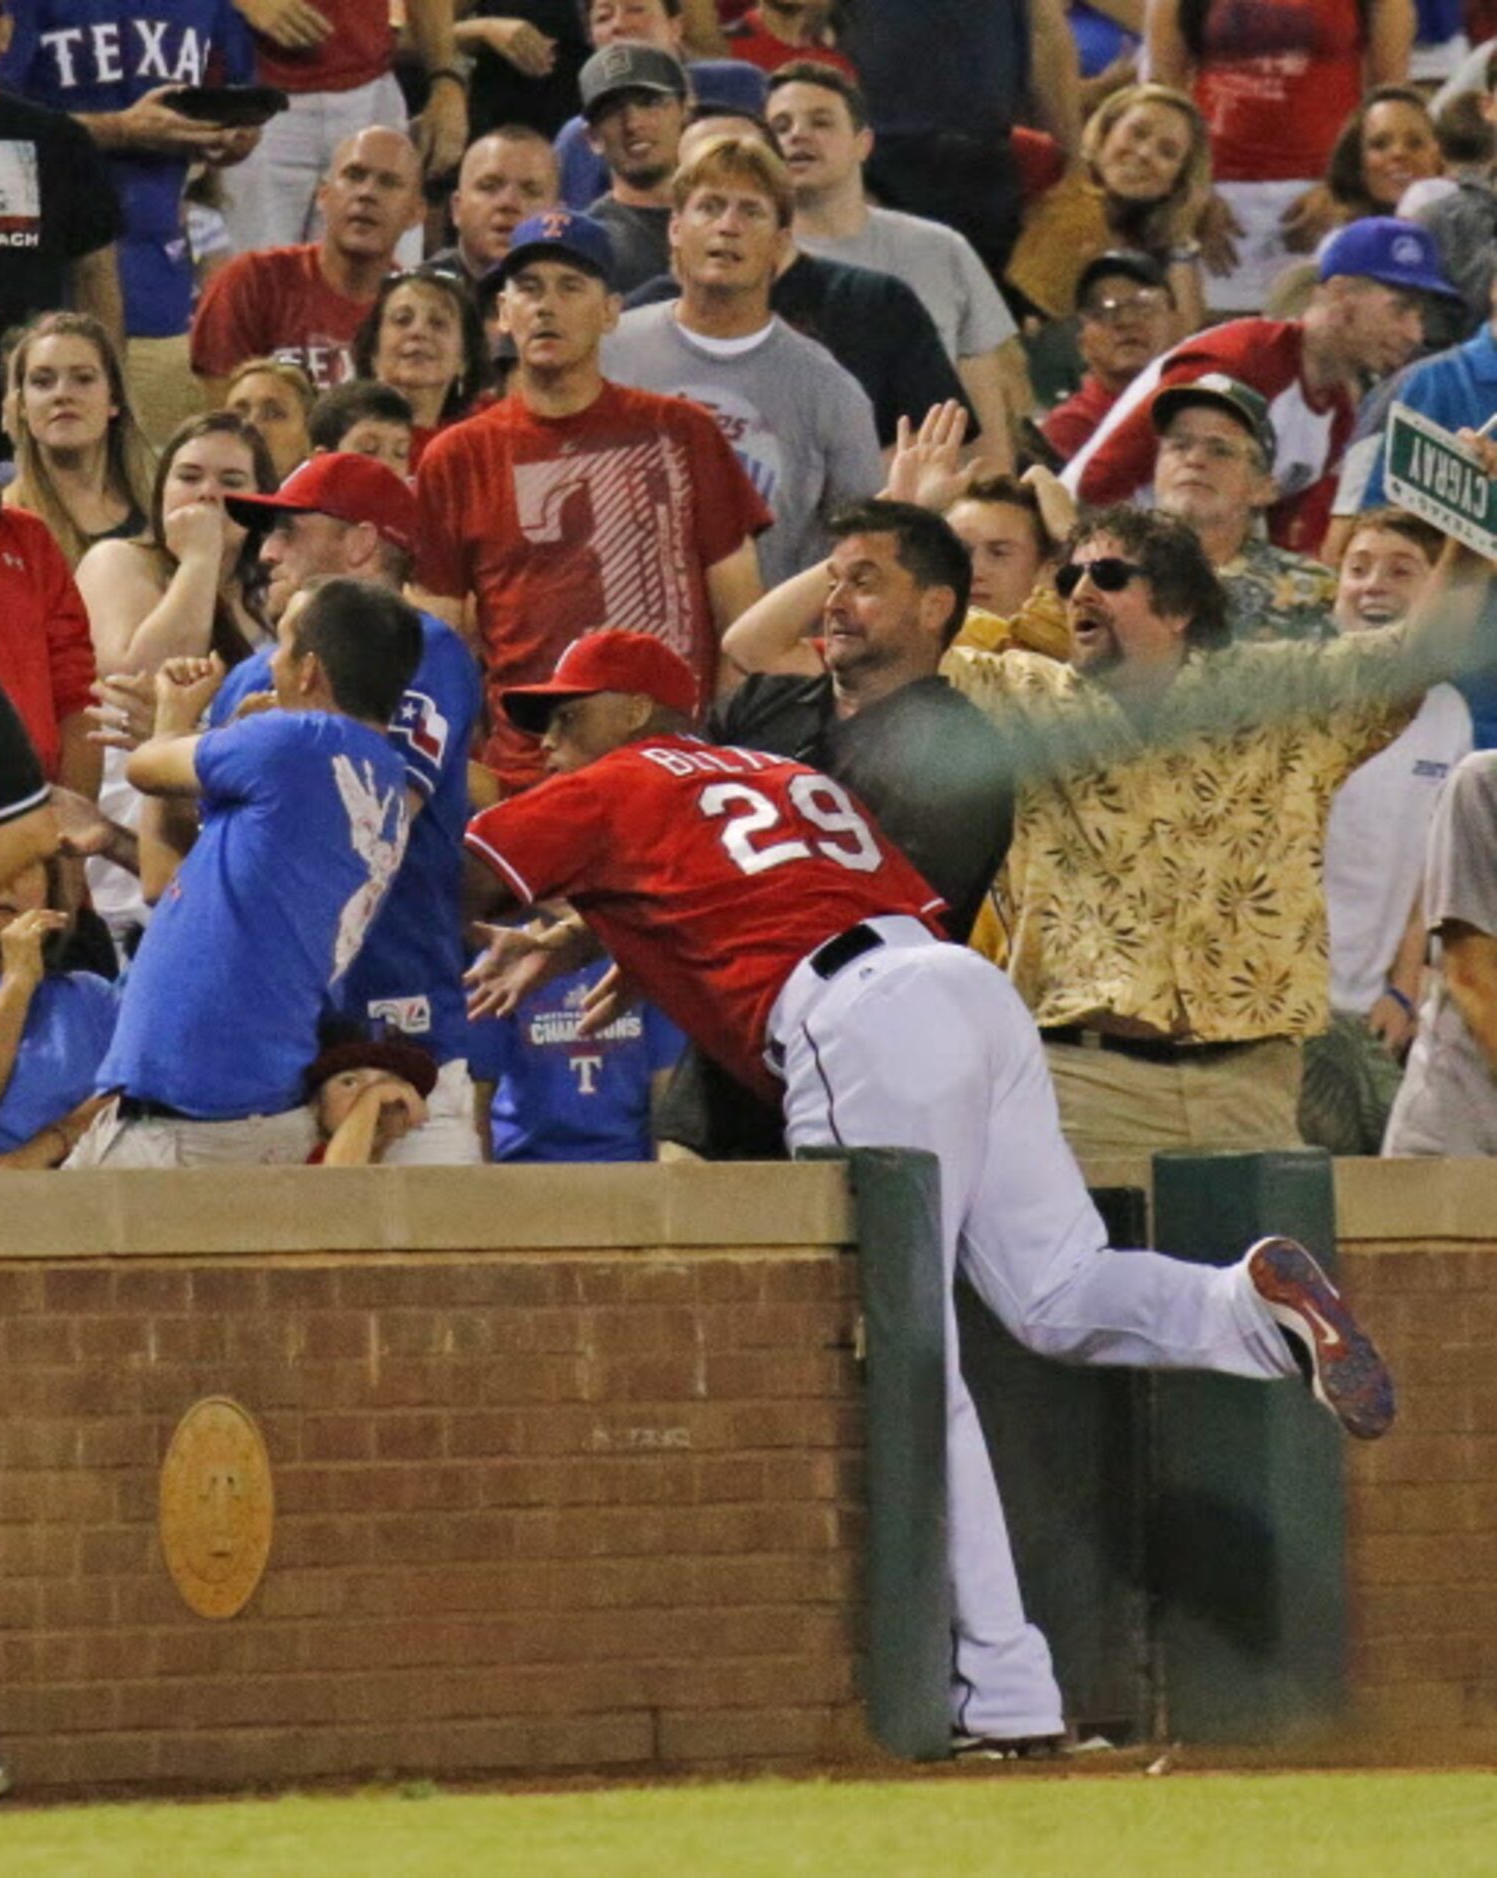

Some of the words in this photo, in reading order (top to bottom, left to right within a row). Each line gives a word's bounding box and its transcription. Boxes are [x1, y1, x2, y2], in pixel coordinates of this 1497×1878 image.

[40, 19, 211, 88] TEXA
[698, 773, 884, 877] 29
[530, 1016, 643, 1046] CHAMONS
[569, 1055, 603, 1095] T
